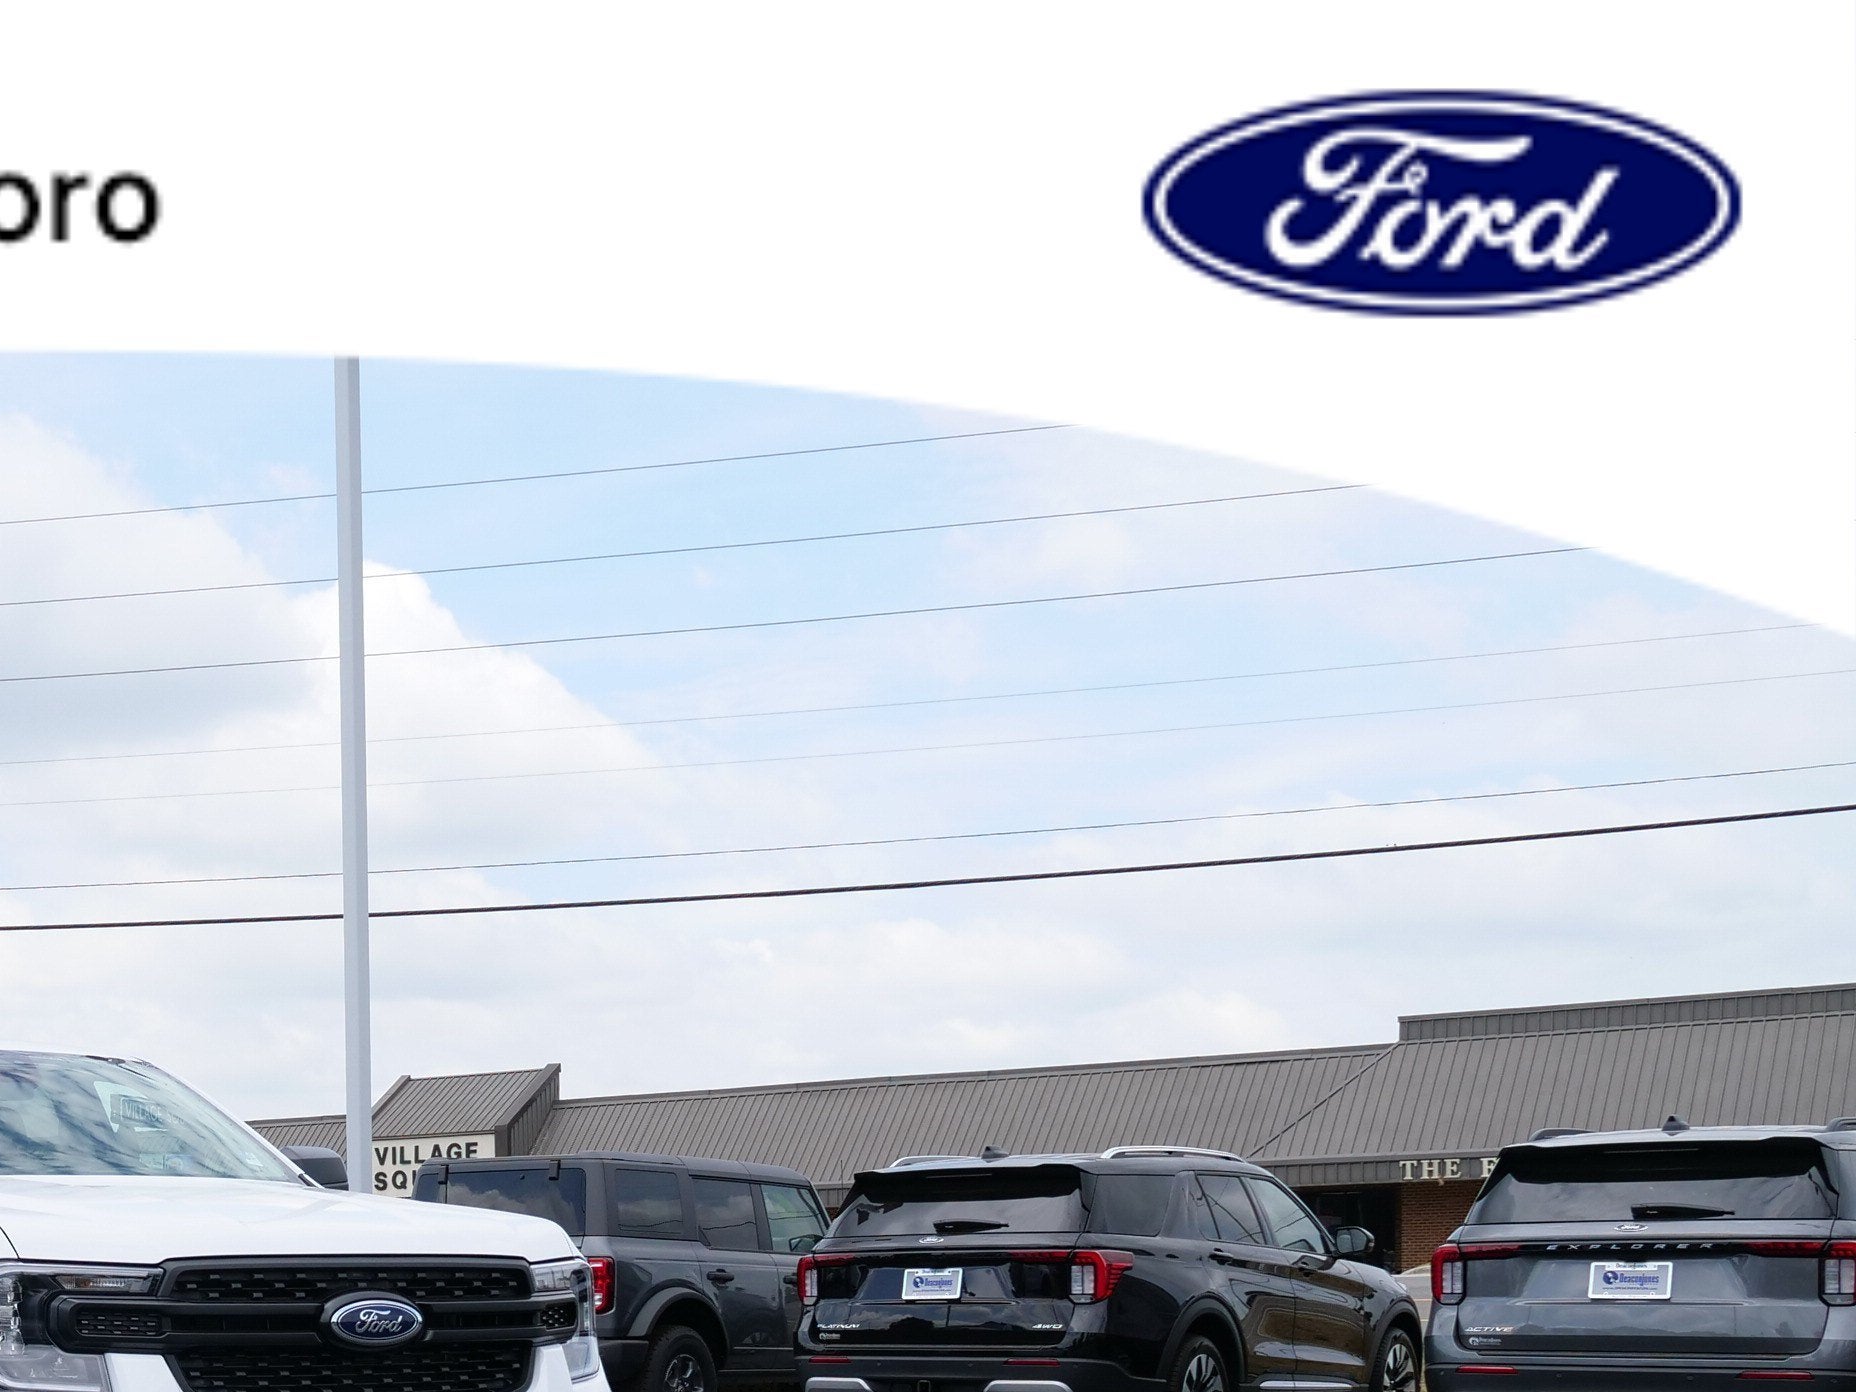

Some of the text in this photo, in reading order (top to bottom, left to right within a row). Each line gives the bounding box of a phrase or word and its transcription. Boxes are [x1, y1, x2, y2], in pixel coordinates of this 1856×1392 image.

[374, 1142, 478, 1165] VILLAGE
[1399, 1159, 1462, 1179] THE
[355, 1309, 403, 1333] Ford
